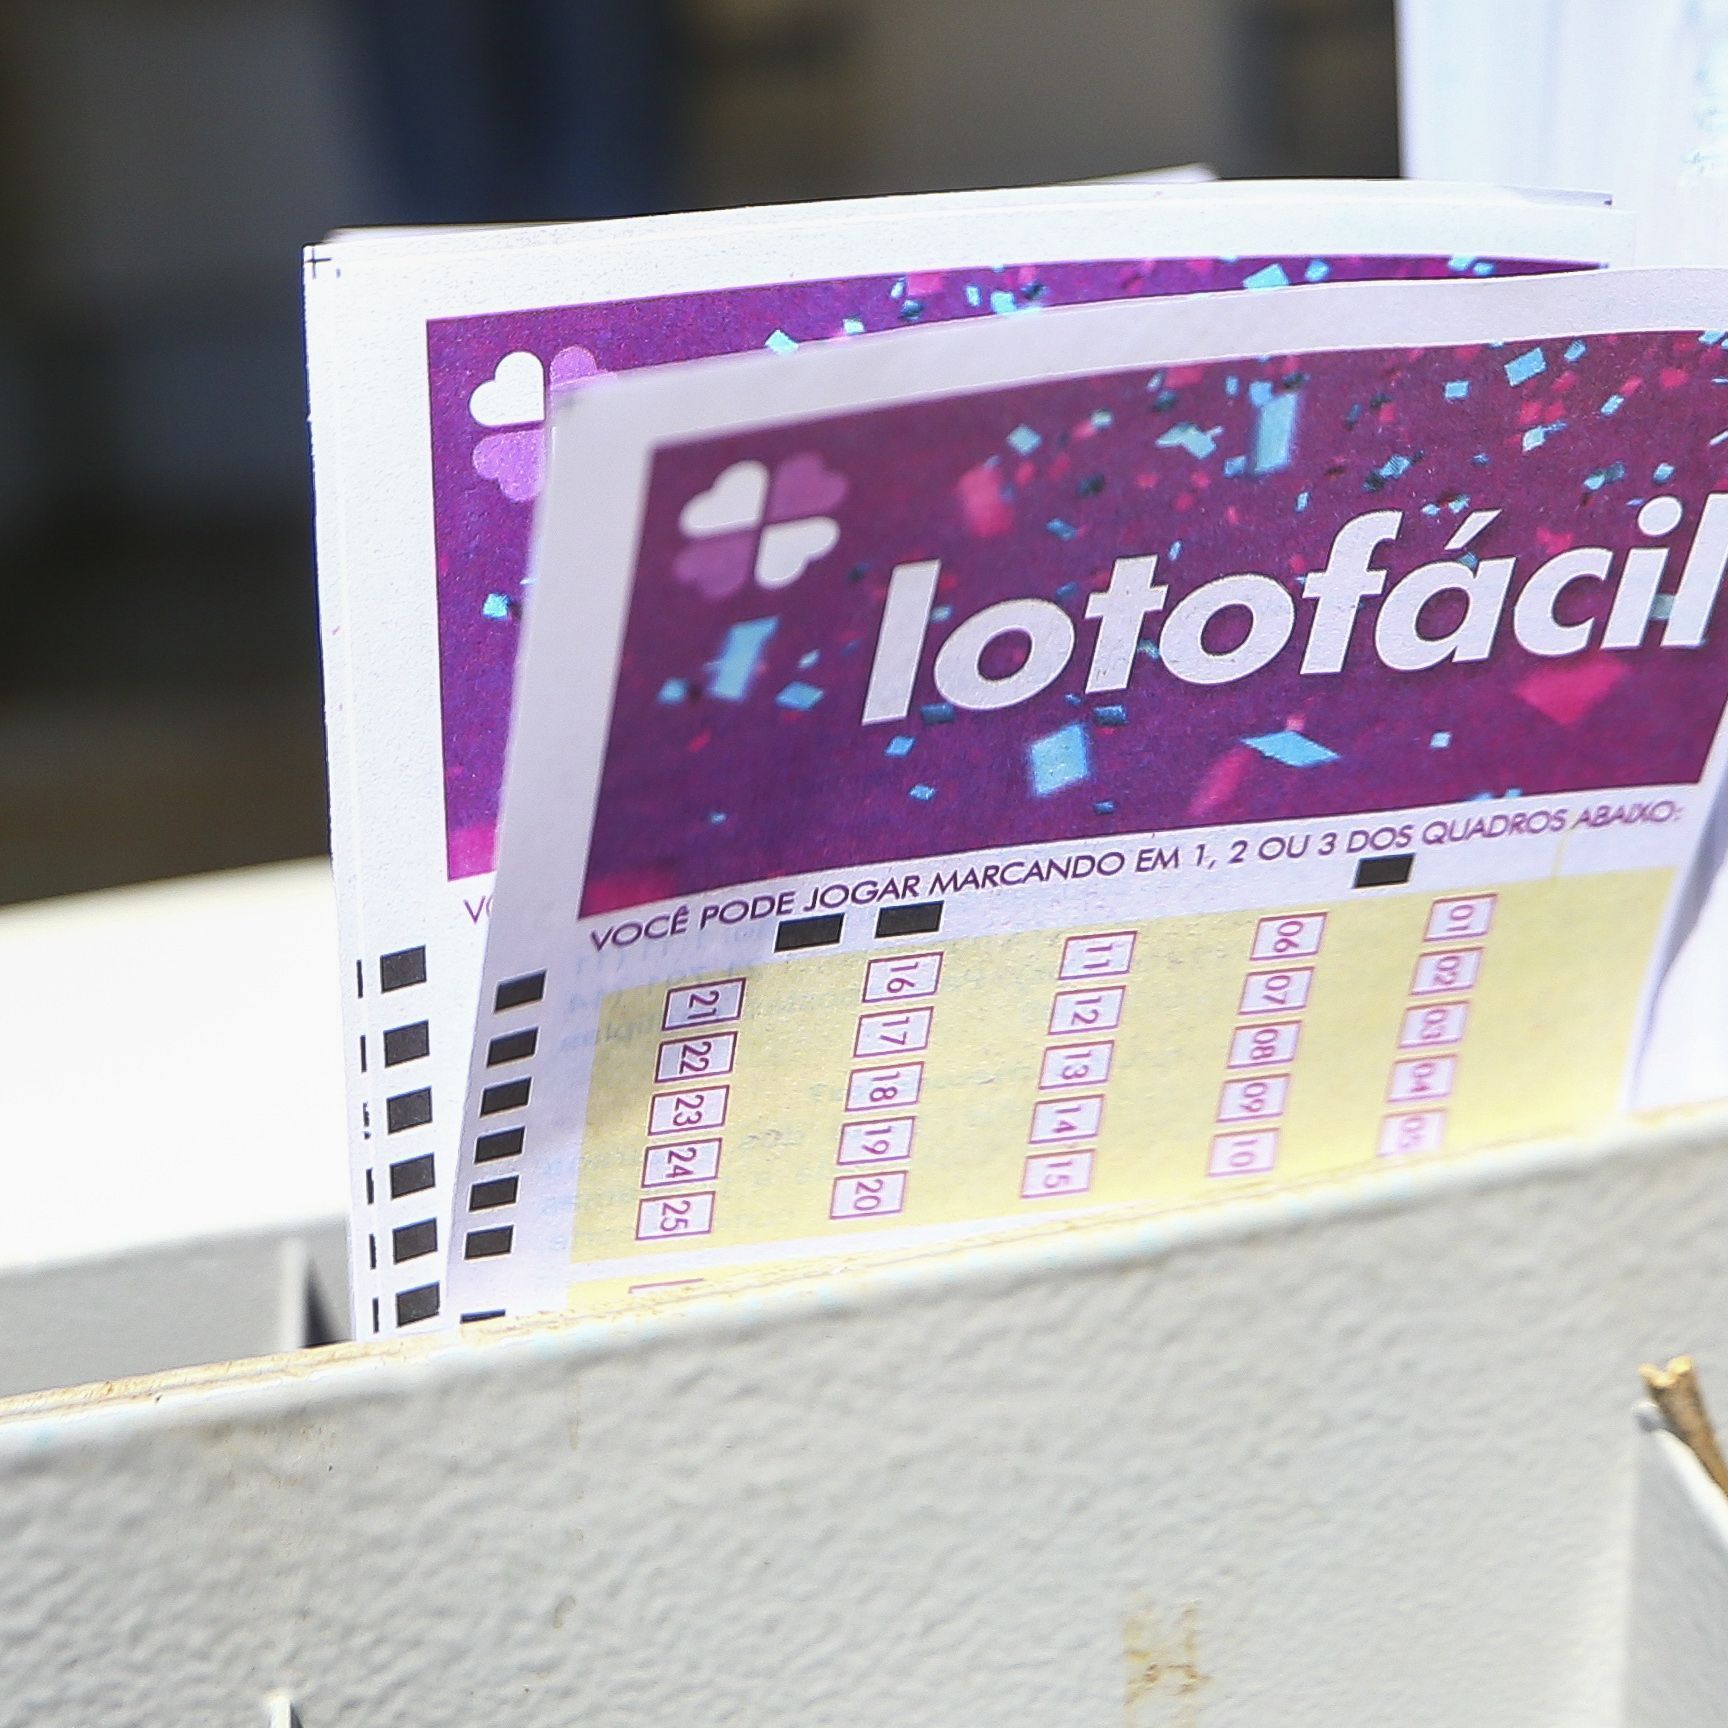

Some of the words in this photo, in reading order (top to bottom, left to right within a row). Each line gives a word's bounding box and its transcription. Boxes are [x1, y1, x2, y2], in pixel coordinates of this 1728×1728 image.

[590, 906, 690, 952] VOCÊ
[699, 892, 795, 930] PODE
[801, 874, 920, 912] JOGAR
[927, 850, 1126, 897] MARCANDO
[1135, 850, 1180, 873] EM
[1193, 844, 1217, 871] 1,
[1229, 840, 1247, 863] 2
[1258, 834, 1309, 860] OU
[1317, 832, 1336, 856] 3
[1346, 825, 1414, 851] DOS
[1422, 808, 1567, 846] QUADROS
[1571, 799, 1684, 829] ABAIXO:
[1446, 904, 1473, 934] 01
[1273, 921, 1304, 954] 06
[1083, 942, 1113, 971] 11
[1432, 956, 1460, 988] 02
[886, 961, 919, 992] 16
[1264, 974, 1291, 1006] 07
[687, 989, 721, 1019] 21
[1071, 995, 1103, 1025] 12
[878, 1015, 911, 1046] 17
[1252, 1028, 1278, 1061] 08
[679, 1041, 712, 1075] 22
[1061, 1050, 1092, 1080] 13
[869, 1070, 901, 1102] 18
[1241, 1082, 1267, 1113] 09
[672, 1094, 705, 1126] 23
[1052, 1105, 1080, 1135] 14
[861, 1125, 893, 1156] 19
[1229, 1137, 1257, 1167] 10
[666, 1147, 697, 1179] 24
[1043, 1158, 1073, 1189] 15
[853, 1178, 883, 1211] 20
[660, 1200, 692, 1232] 25
